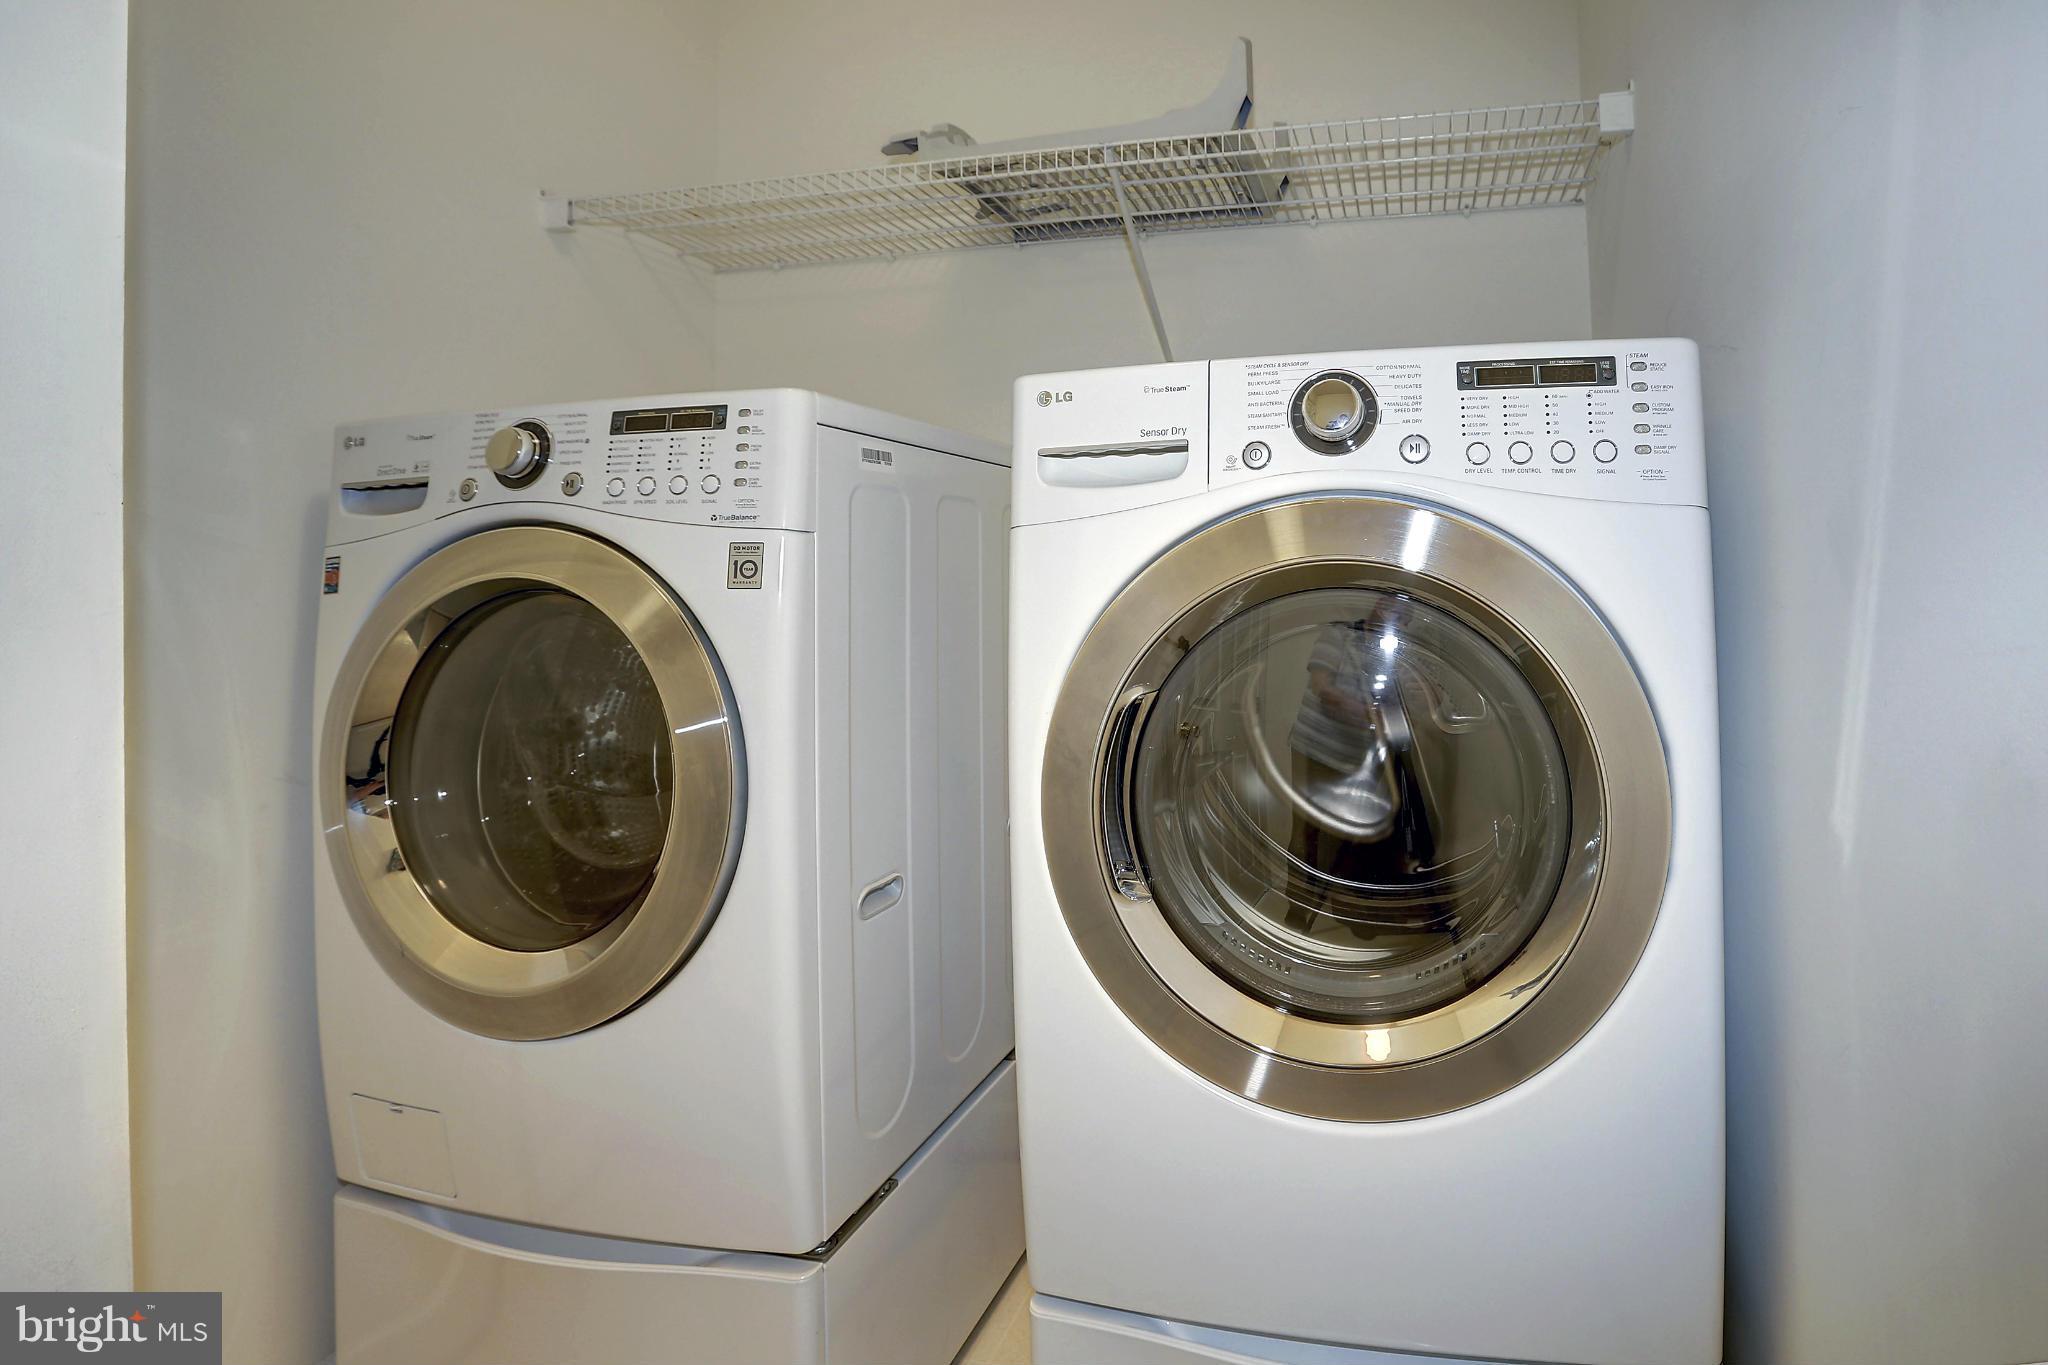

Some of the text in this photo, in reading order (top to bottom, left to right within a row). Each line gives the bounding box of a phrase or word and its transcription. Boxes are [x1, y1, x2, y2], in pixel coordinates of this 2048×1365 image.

[1056, 391, 1072, 402] LG
[1140, 426, 1188, 438] Sensor Dry
[733, 560, 758, 579] 10
